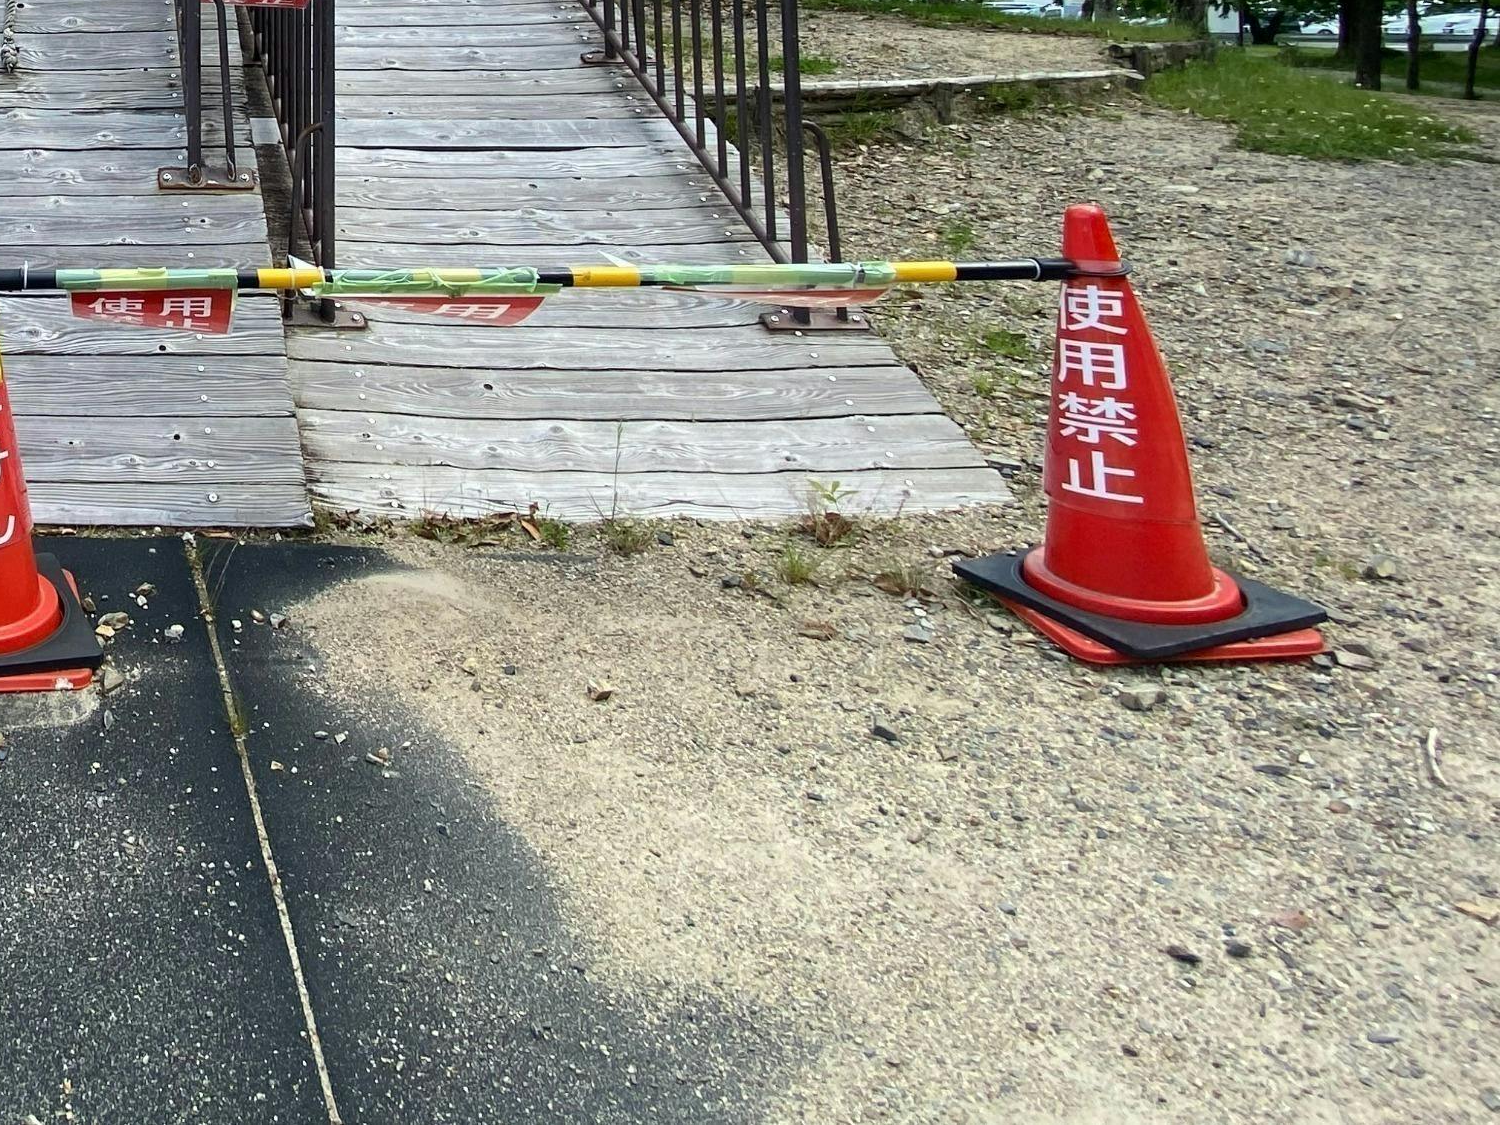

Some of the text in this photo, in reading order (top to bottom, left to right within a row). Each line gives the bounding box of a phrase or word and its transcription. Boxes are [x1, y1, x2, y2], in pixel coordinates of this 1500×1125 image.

[88, 297, 213, 317] 使用
[1059, 283, 1144, 505] 使用禁止
